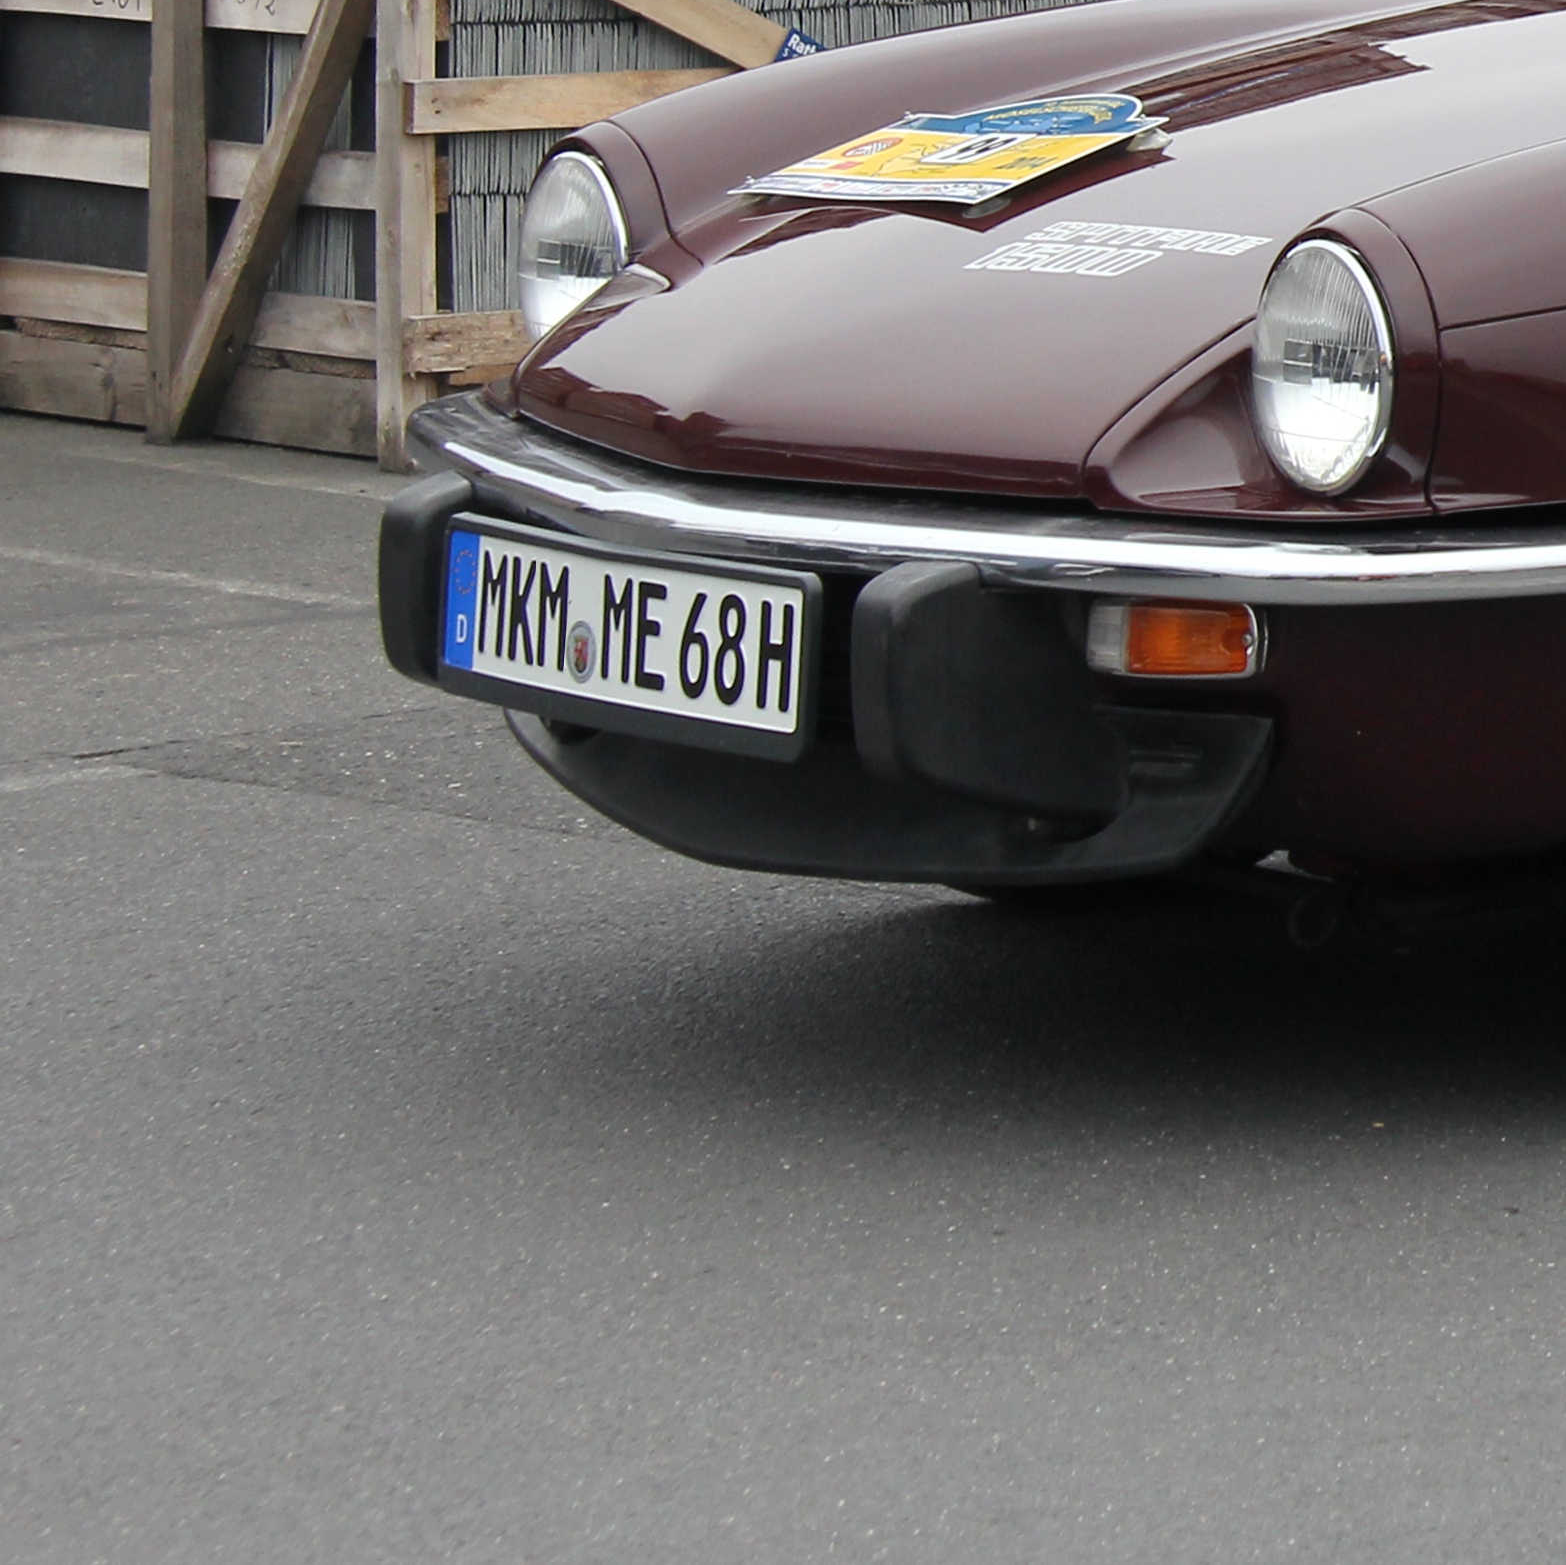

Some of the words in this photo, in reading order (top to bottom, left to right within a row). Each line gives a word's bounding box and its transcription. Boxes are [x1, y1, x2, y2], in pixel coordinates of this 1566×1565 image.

[455, 614, 468, 644] D
[477, 549, 570, 673] MKM
[600, 572, 668, 692] ME
[679, 591, 795, 714] 68H
